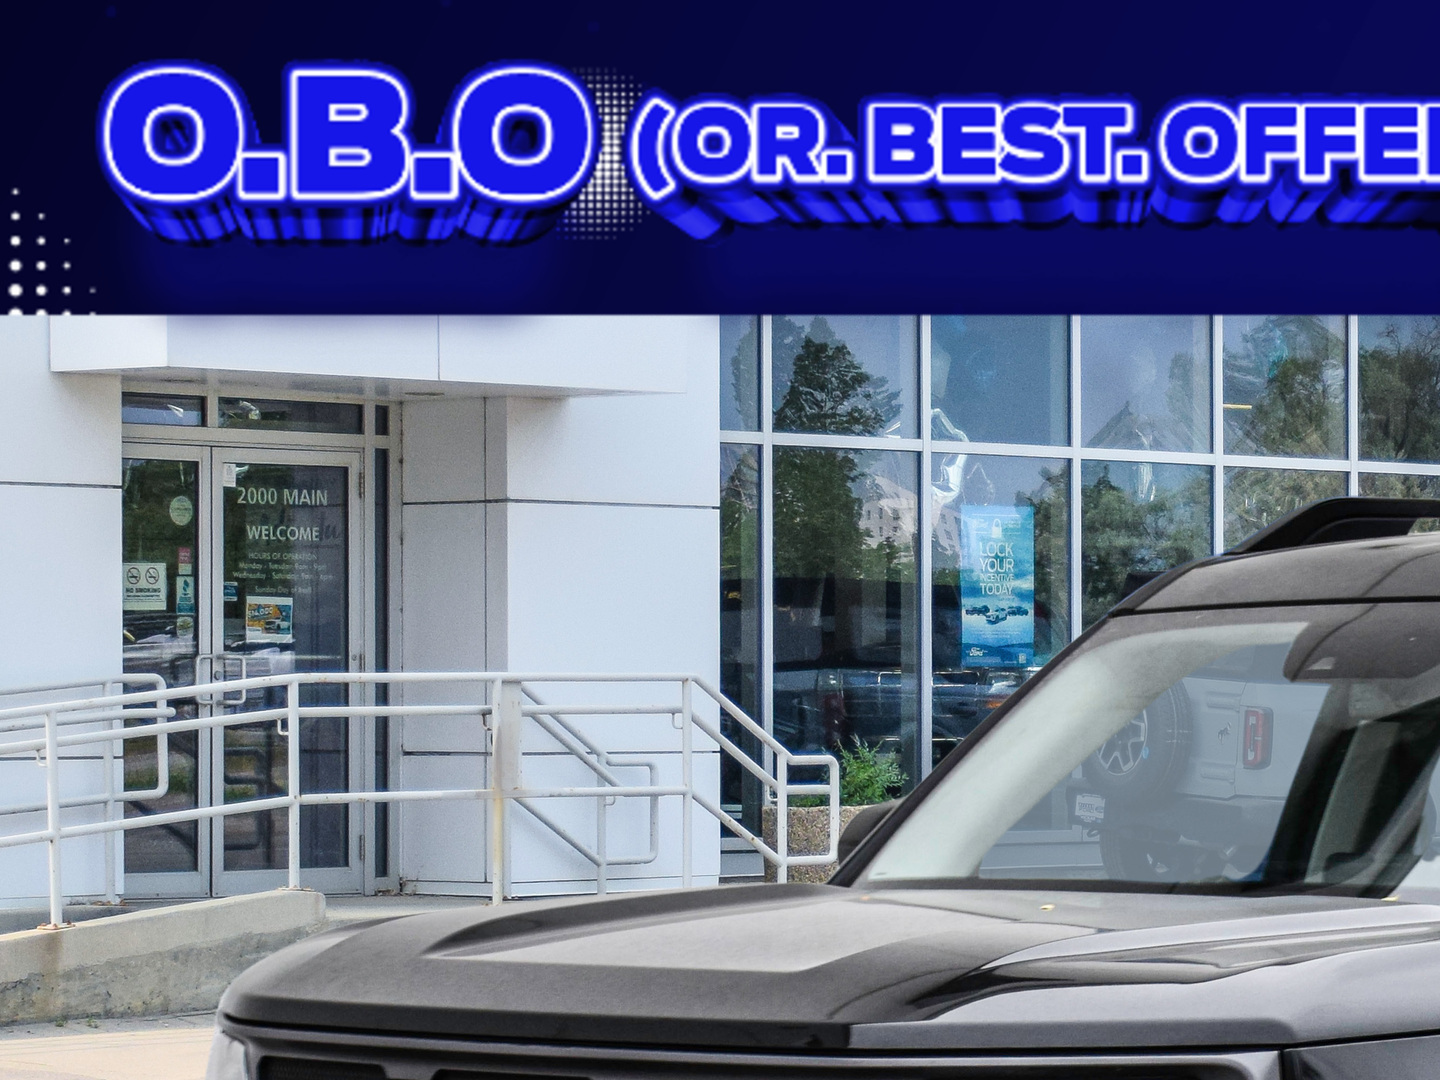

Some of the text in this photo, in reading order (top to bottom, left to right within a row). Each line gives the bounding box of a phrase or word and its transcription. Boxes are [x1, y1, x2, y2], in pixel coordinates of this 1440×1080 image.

[237, 487, 328, 506] 2000 MAIN
[246, 525, 320, 541] WELCOME
[980, 541, 1014, 557] LOCK
[980, 558, 1014, 573] YOUR
[980, 583, 1013, 595] TODAY
